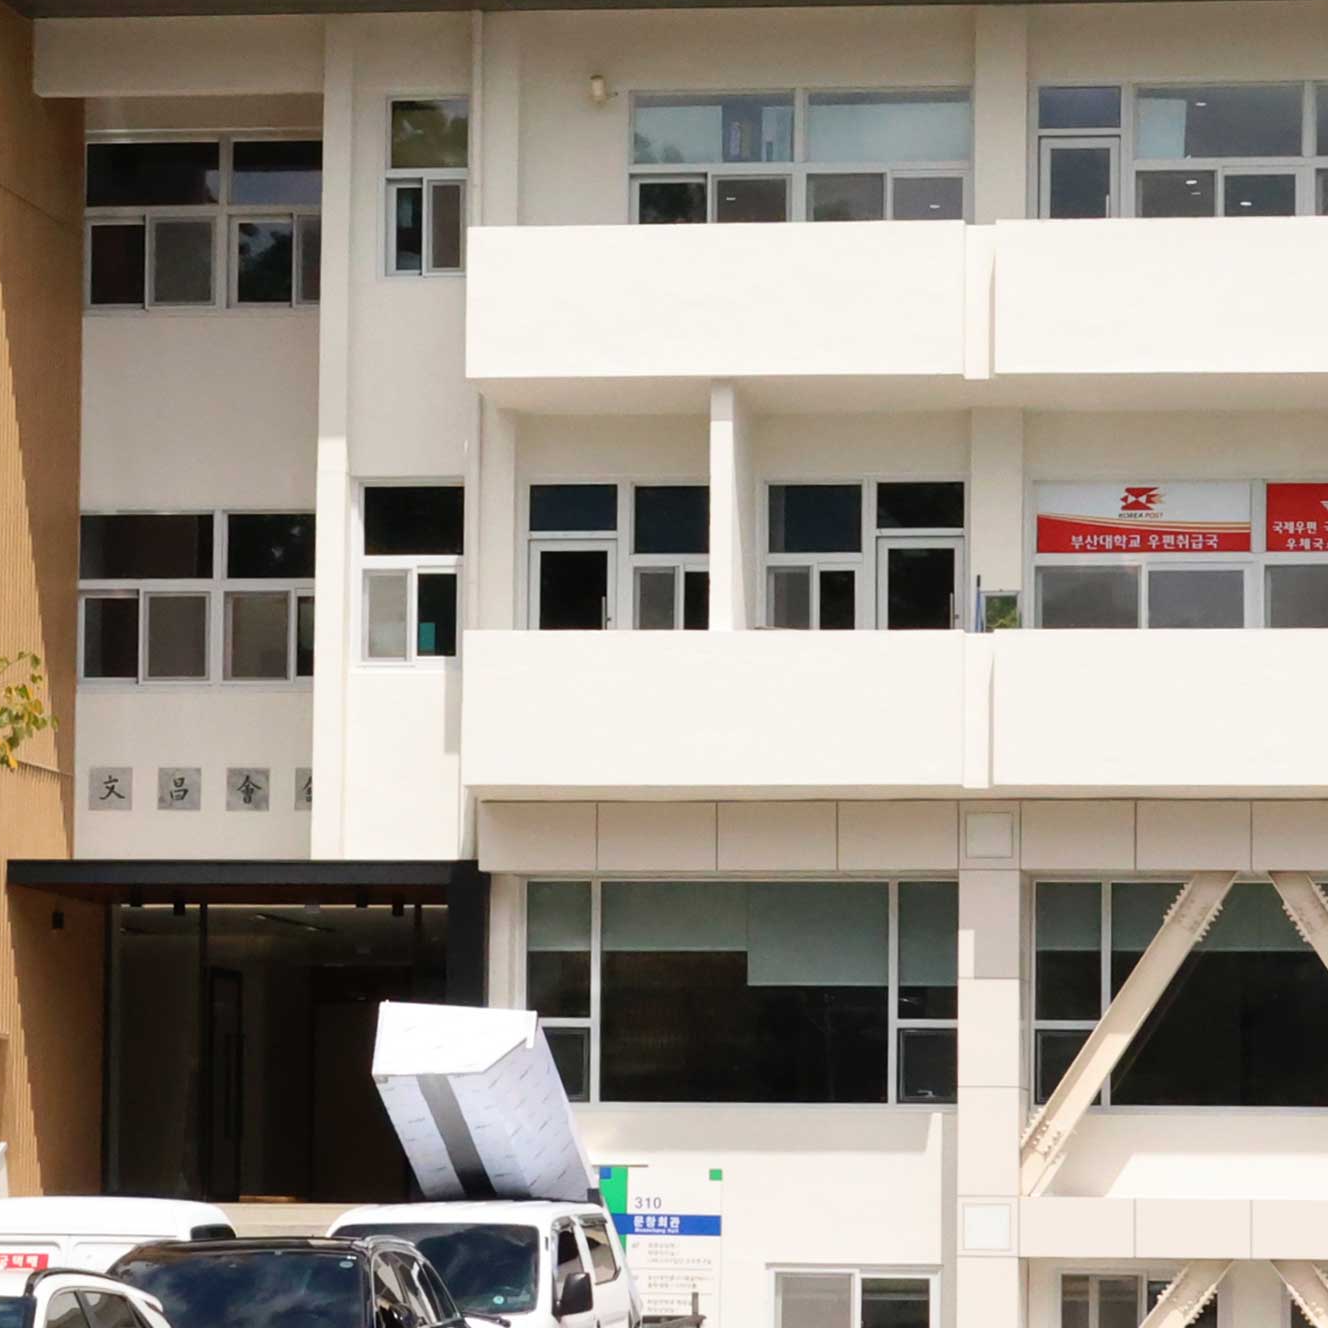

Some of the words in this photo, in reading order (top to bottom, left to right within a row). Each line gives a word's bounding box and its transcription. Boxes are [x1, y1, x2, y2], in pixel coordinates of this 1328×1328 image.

[1272, 521, 1317, 533] 국제우편
[1071, 535, 1141, 549] 부산대학교
[1147, 534, 1219, 549] 우편취급국
[635, 1197, 662, 1209] 310
